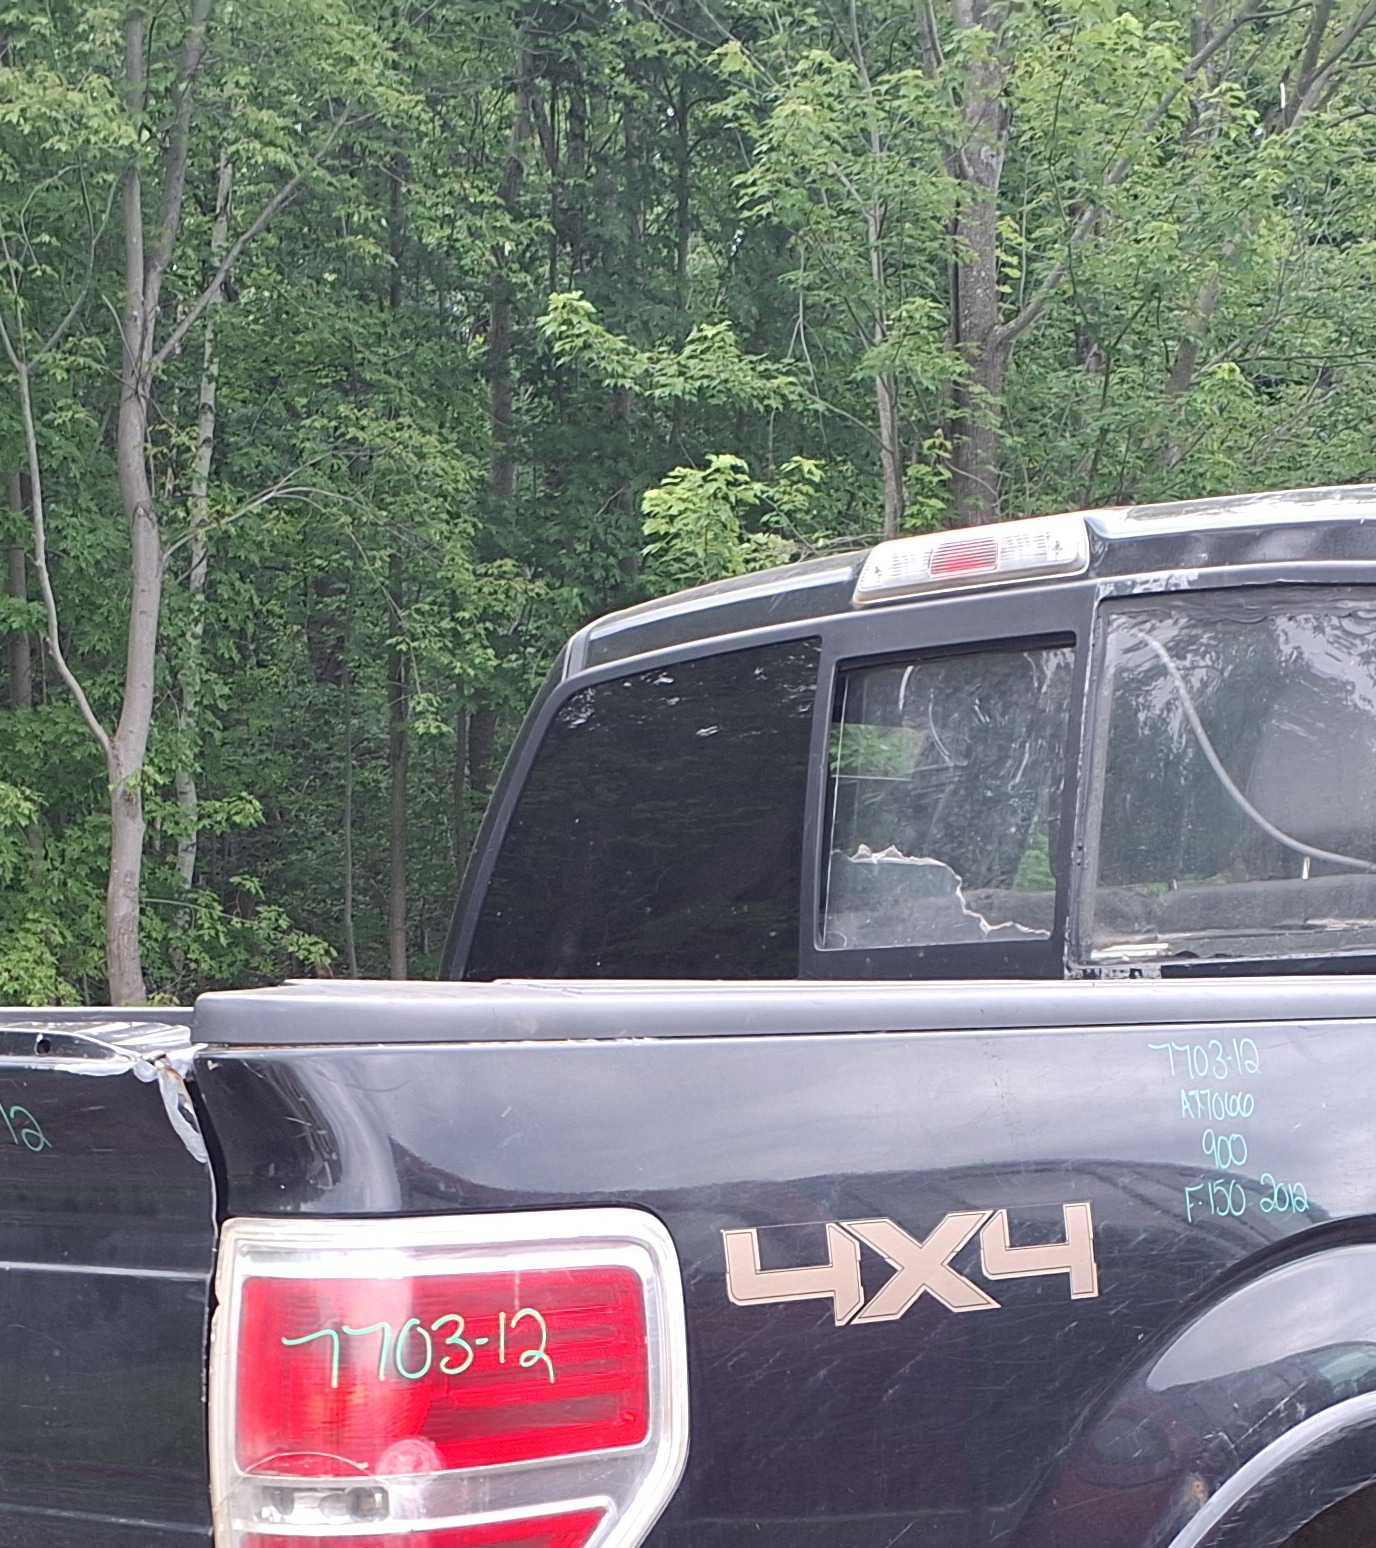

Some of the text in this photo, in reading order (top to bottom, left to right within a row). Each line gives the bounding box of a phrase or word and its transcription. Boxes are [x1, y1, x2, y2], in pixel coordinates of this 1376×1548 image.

[1148, 1037, 1262, 1080] 7703-12
[1202, 1128, 1248, 1170] 900
[1260, 1172, 1309, 1214] 2012
[282, 1308, 556, 1388] 7703-12
